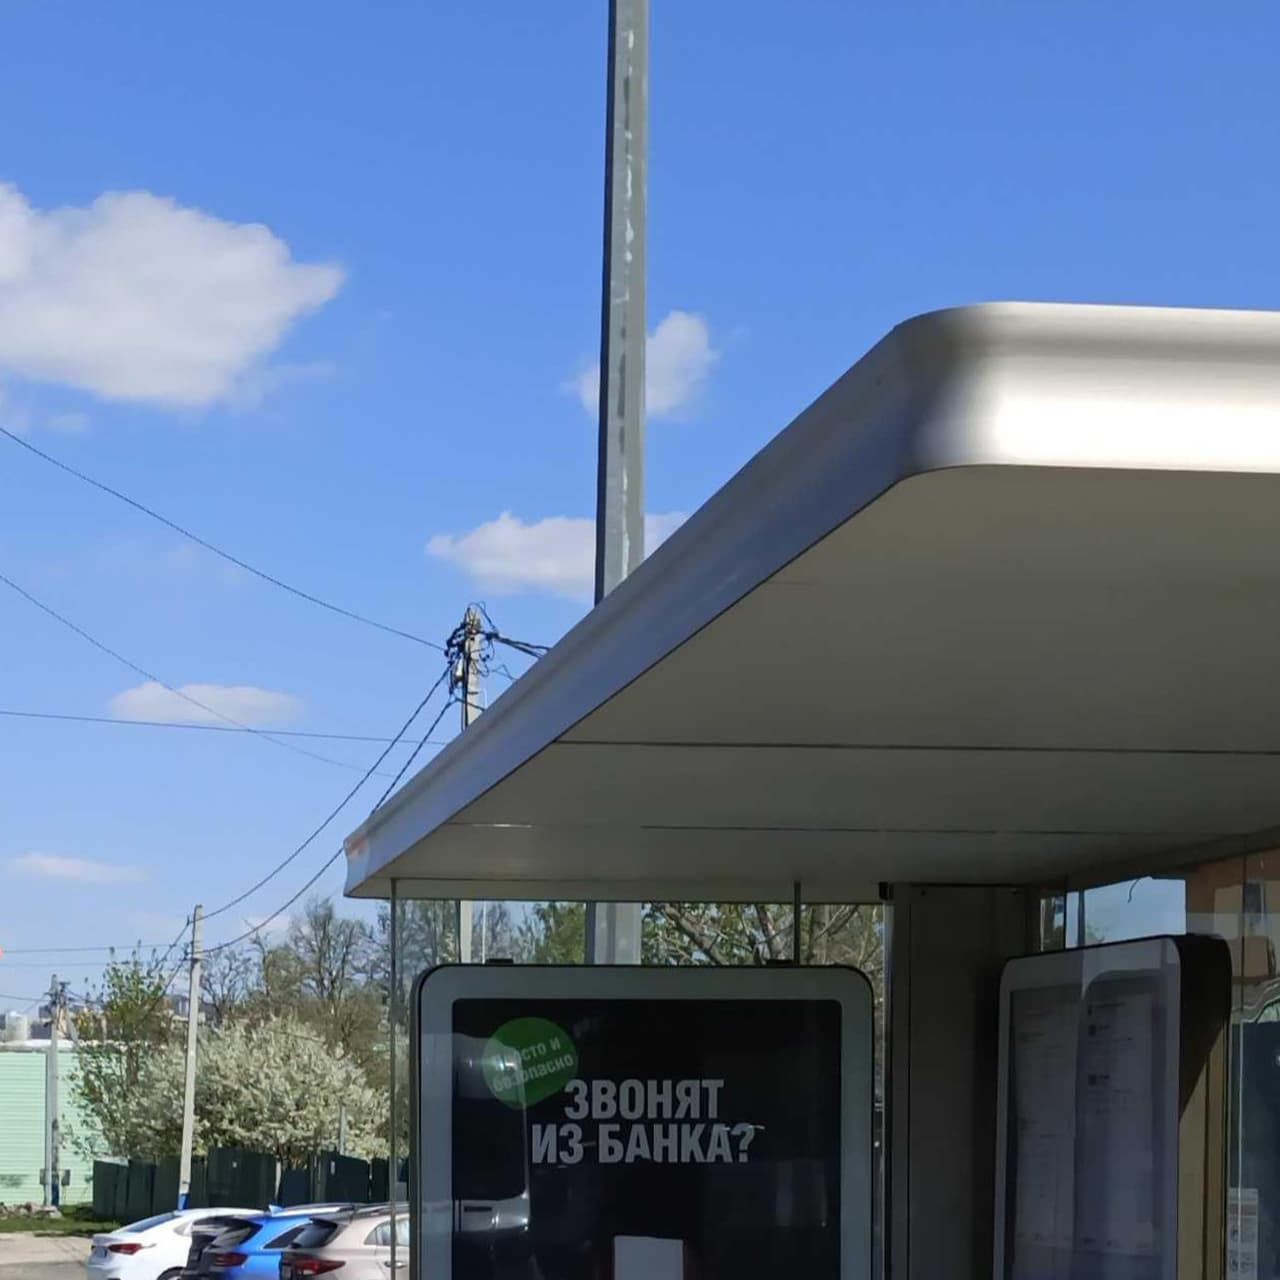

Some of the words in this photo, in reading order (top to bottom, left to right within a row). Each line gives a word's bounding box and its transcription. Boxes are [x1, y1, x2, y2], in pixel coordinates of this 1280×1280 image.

[564, 1079, 724, 1119] ЗВОНЯТ
[532, 1124, 584, 1164] ИЗ
[598, 1123, 756, 1164] БАНКА?
